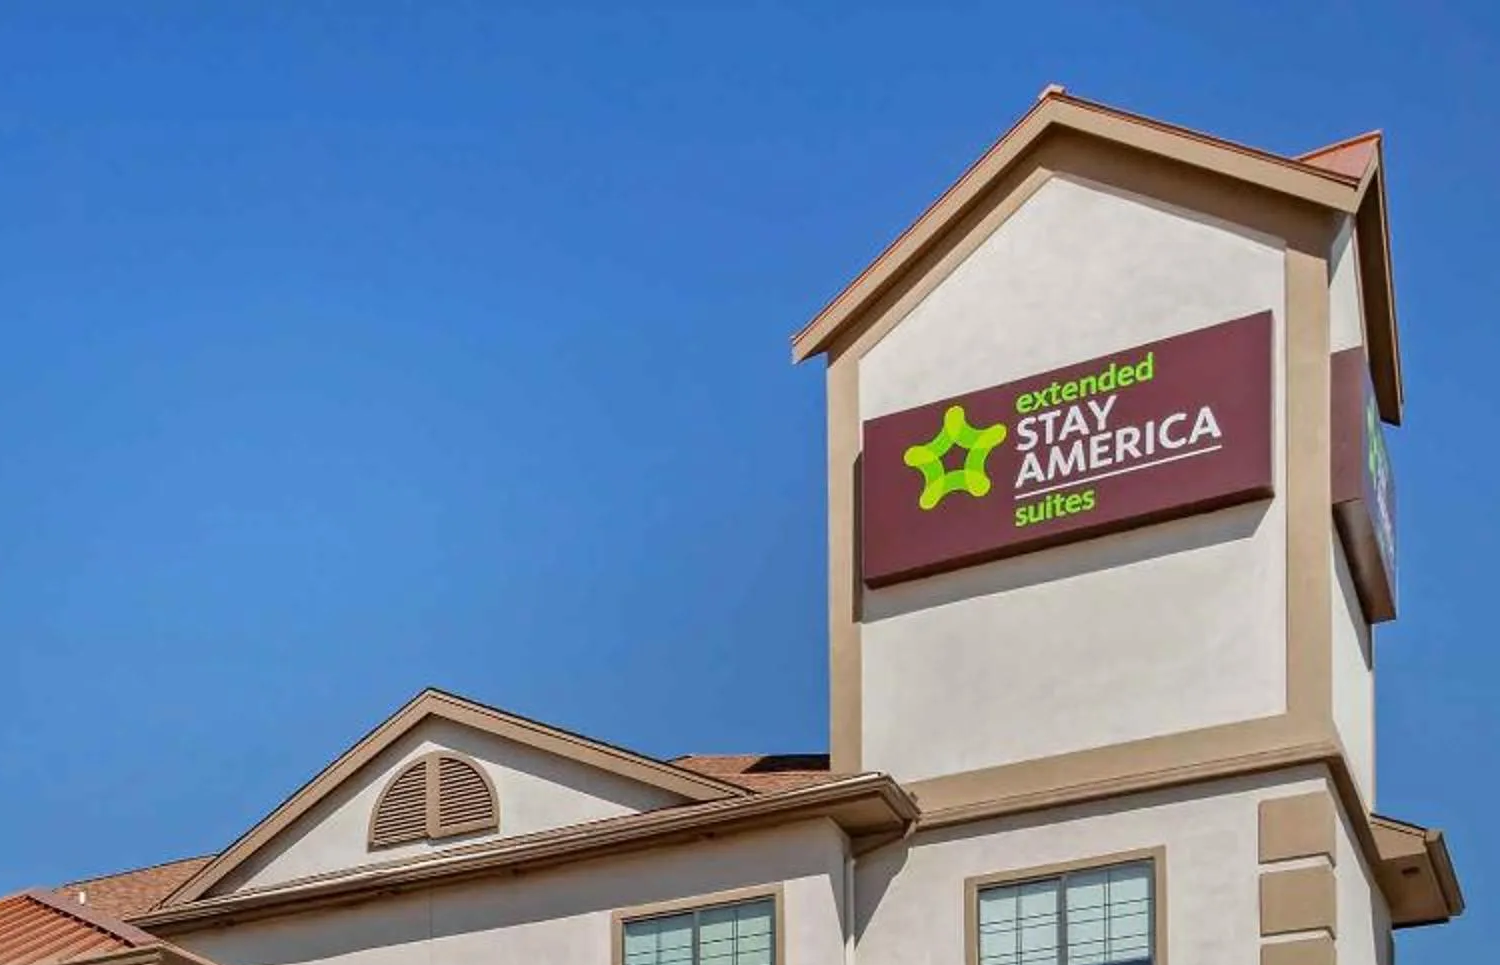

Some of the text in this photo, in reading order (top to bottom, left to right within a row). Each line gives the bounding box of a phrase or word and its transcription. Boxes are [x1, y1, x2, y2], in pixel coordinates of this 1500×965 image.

[1015, 352, 1155, 414] extended
[1014, 406, 1223, 489] AMERICA
[1015, 395, 1117, 451] STAY
[1014, 489, 1096, 528] suites
